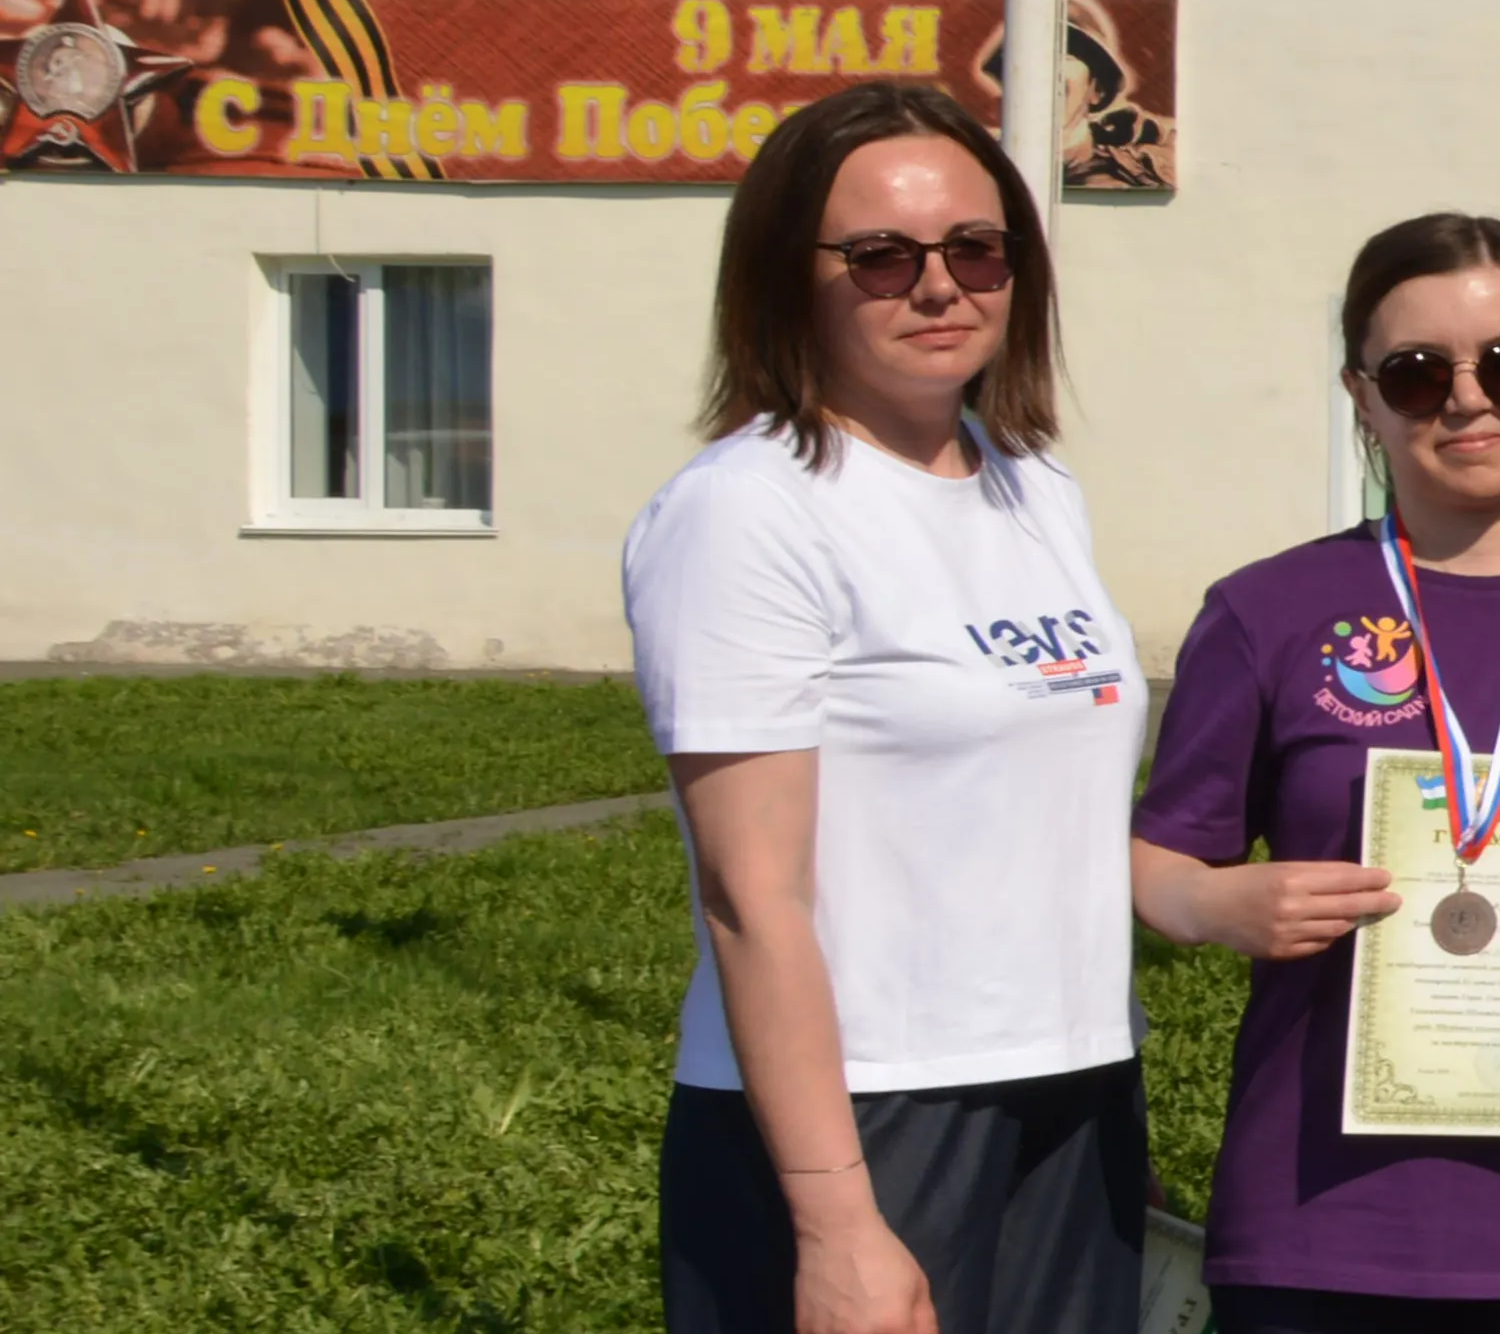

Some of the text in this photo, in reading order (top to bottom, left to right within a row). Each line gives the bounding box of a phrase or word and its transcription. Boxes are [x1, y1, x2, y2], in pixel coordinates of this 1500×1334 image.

[748, 6, 942, 75] МАЯ
[197, 77, 804, 163] С Днём Побе
[1313, 687, 1383, 728] ДЕТСКИЙ
[1383, 704, 1420, 725] САД
